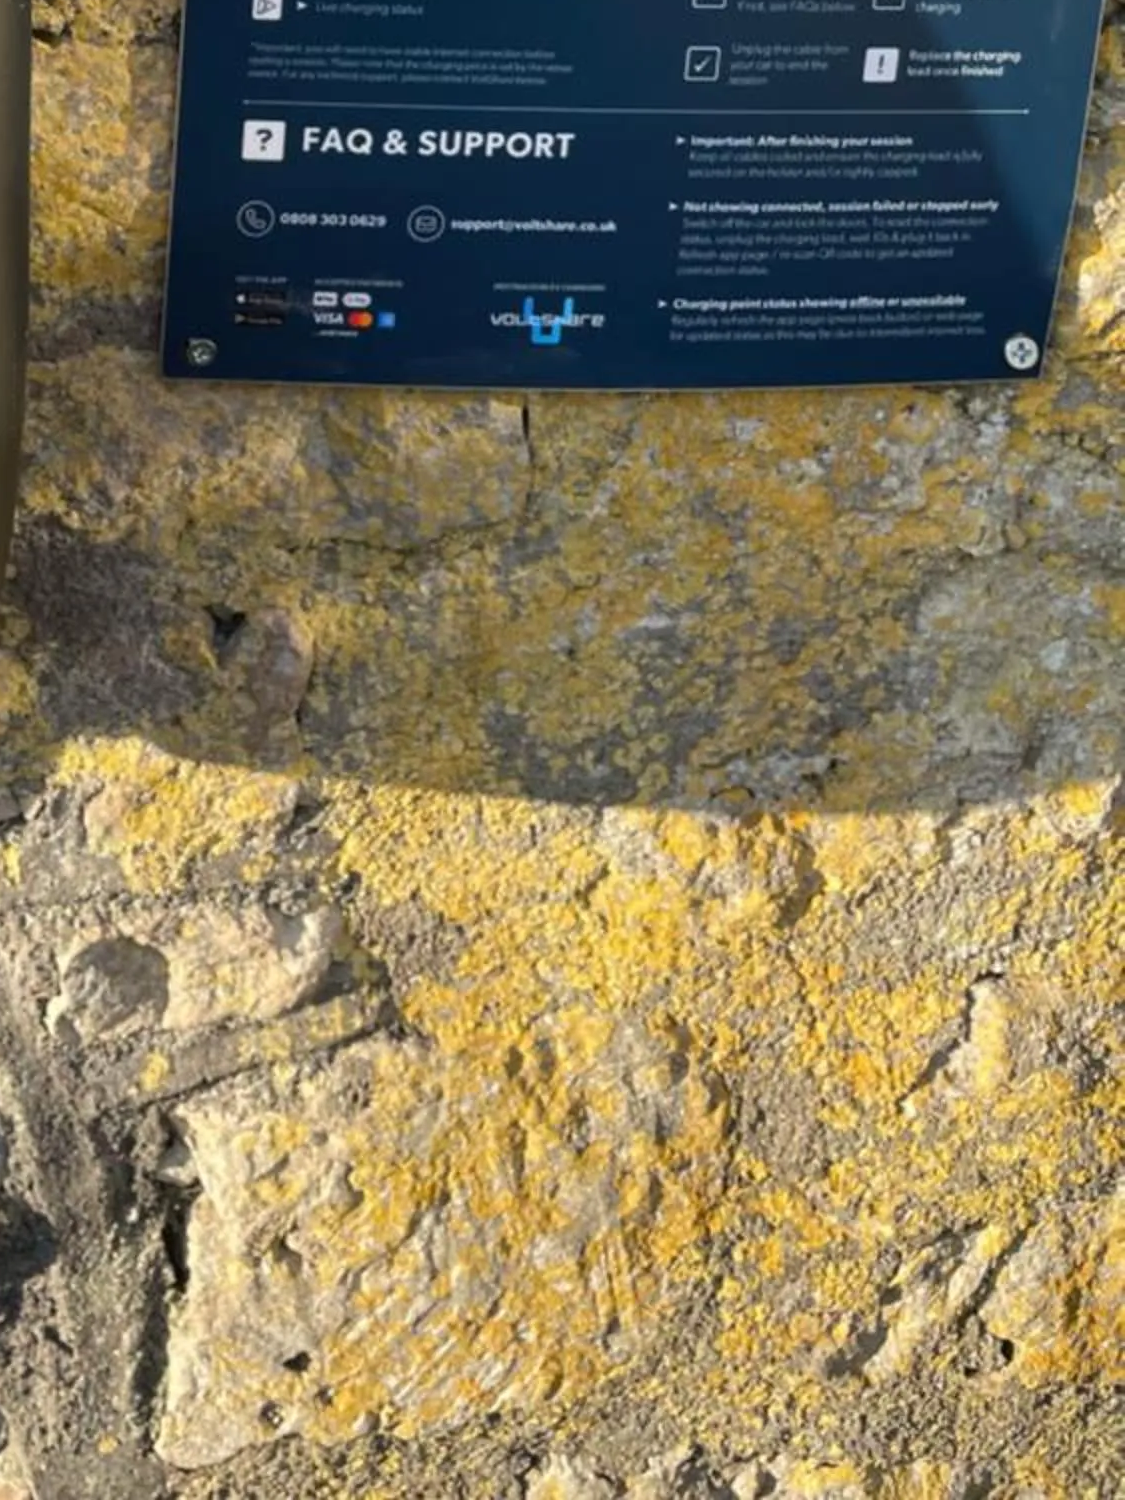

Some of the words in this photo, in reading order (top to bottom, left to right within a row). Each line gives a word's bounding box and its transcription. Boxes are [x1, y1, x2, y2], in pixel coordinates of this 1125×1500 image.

[301, 126, 373, 156] FAQ
[383, 128, 407, 156] &
[418, 130, 576, 159] SUPPORT
[690, 134, 755, 148] Important:
[757, 134, 788, 147] After
[789, 133, 840, 148] finishing
[841, 136, 869, 149] your
[870, 135, 913, 147] session
[683, 200, 708, 213] Not
[708, 200, 760, 215] showing
[828, 201, 870, 213] session
[872, 199, 906, 212] failed
[907, 201, 919, 212] or
[970, 199, 1000, 213] early
[278, 211, 318, 226] 0808
[319, 212, 348, 227] 303
[349, 213, 388, 228] 0629
[451, 218, 617, 233] support@voltshare.co.uk
[672, 298, 728, 312] Charging
[729, 298, 762, 312] point
[763, 297, 798, 309] status
[799, 297, 848, 311] showing
[312, 312, 345, 325] VISA
